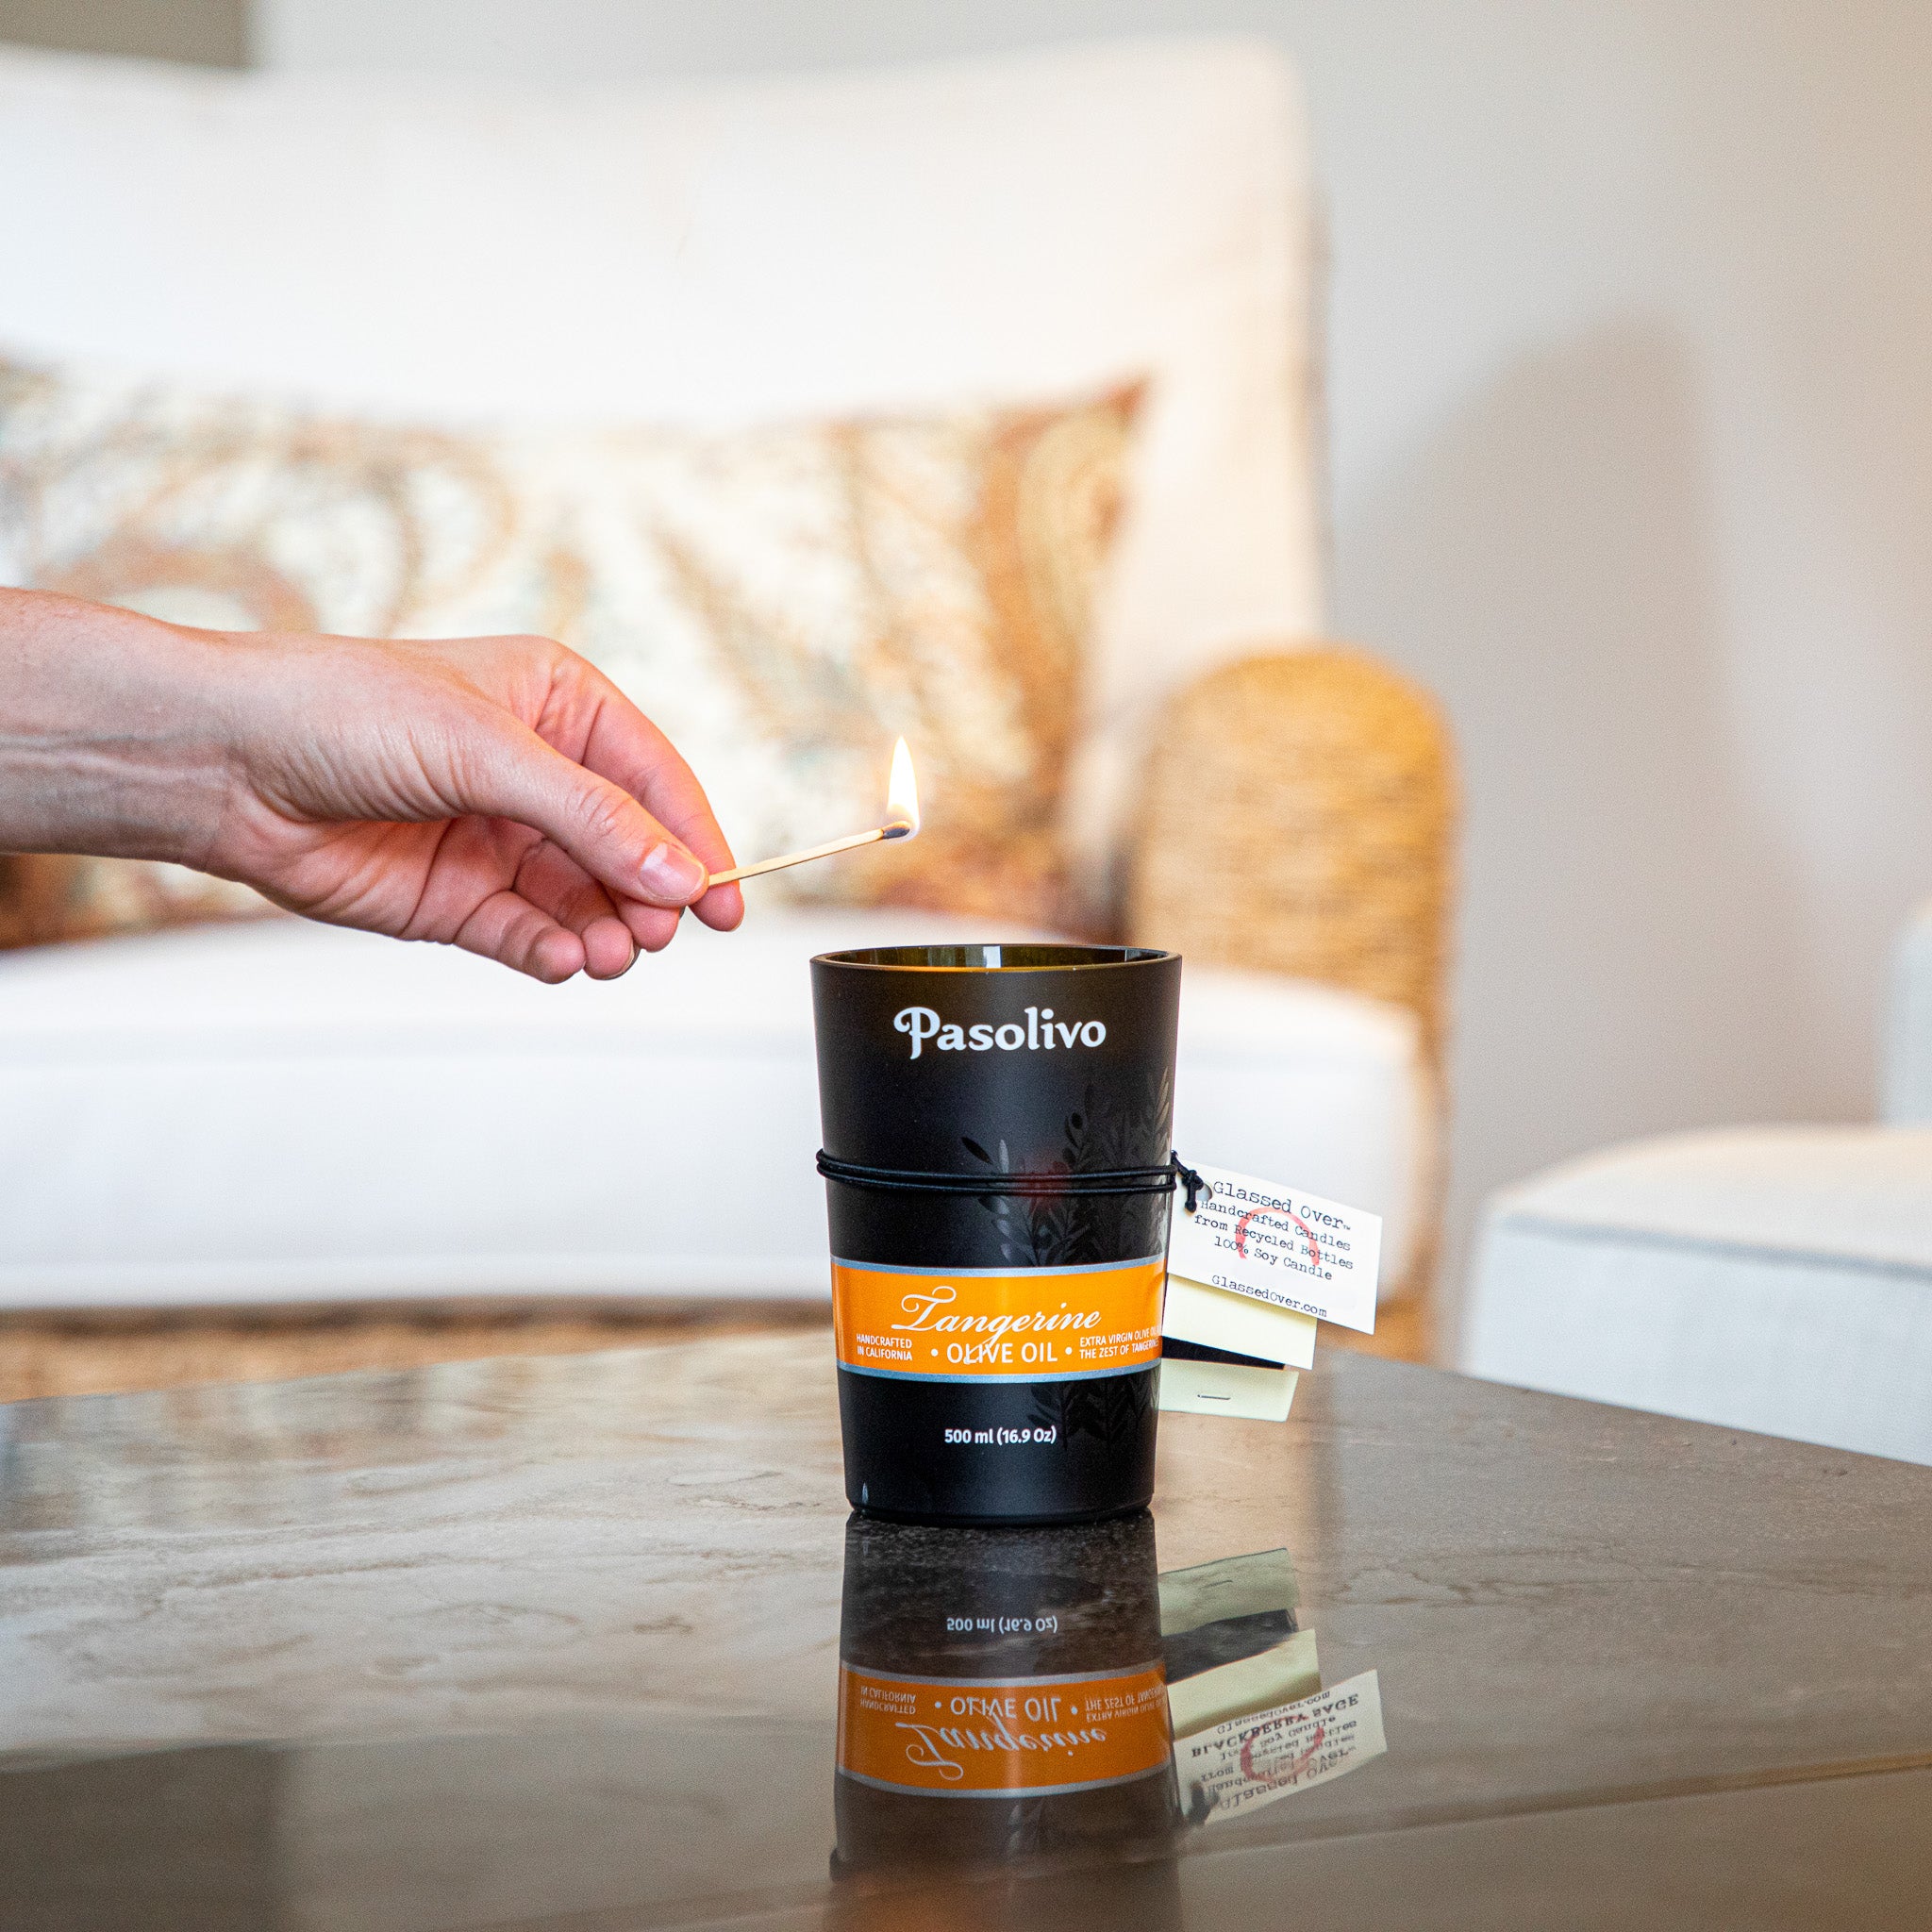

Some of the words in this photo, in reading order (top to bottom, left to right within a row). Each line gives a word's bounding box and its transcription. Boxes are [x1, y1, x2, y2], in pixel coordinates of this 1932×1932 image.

[893, 1007, 1107, 1060] Pasolivo
[1213, 1181, 1291, 1214] Glassed
[1194, 1214, 1228, 1231] from
[1234, 1224, 1294, 1253] Recycled
[1301, 1244, 1354, 1270] Bottles
[1200, 1200, 1289, 1232] Handcrafted
[1294, 1225, 1351, 1251] Candles
[1214, 1236, 1249, 1254] 100%
[1254, 1247, 1278, 1266] Soy
[1283, 1257, 1332, 1280] Candle
[1211, 1274, 1327, 1318] GlassedOver.com
[857, 1333, 912, 1349] HANDCRAFTED
[891, 1286, 1102, 1364] Tangerine
[1079, 1335, 1107, 1348] EXTRA
[1108, 1331, 1133, 1344] VIRGIN
[1134, 1327, 1150, 1341] OLIVE
[857, 1345, 864, 1356] IN
[865, 1346, 913, 1361] CALIFORNIA
[946, 1342, 1013, 1364] OLIVE
[1021, 1341, 1058, 1363] OIL
[1079, 1349, 1097, 1359] THE
[1099, 1345, 1119, 1358] ZEST
[1120, 1344, 1129, 1356] OF
[944, 1428, 972, 1443] 500
[974, 1428, 994, 1444] ml
[996, 1426, 1031, 1445] (16.9
[1033, 1424, 1057, 1444] Oz)
